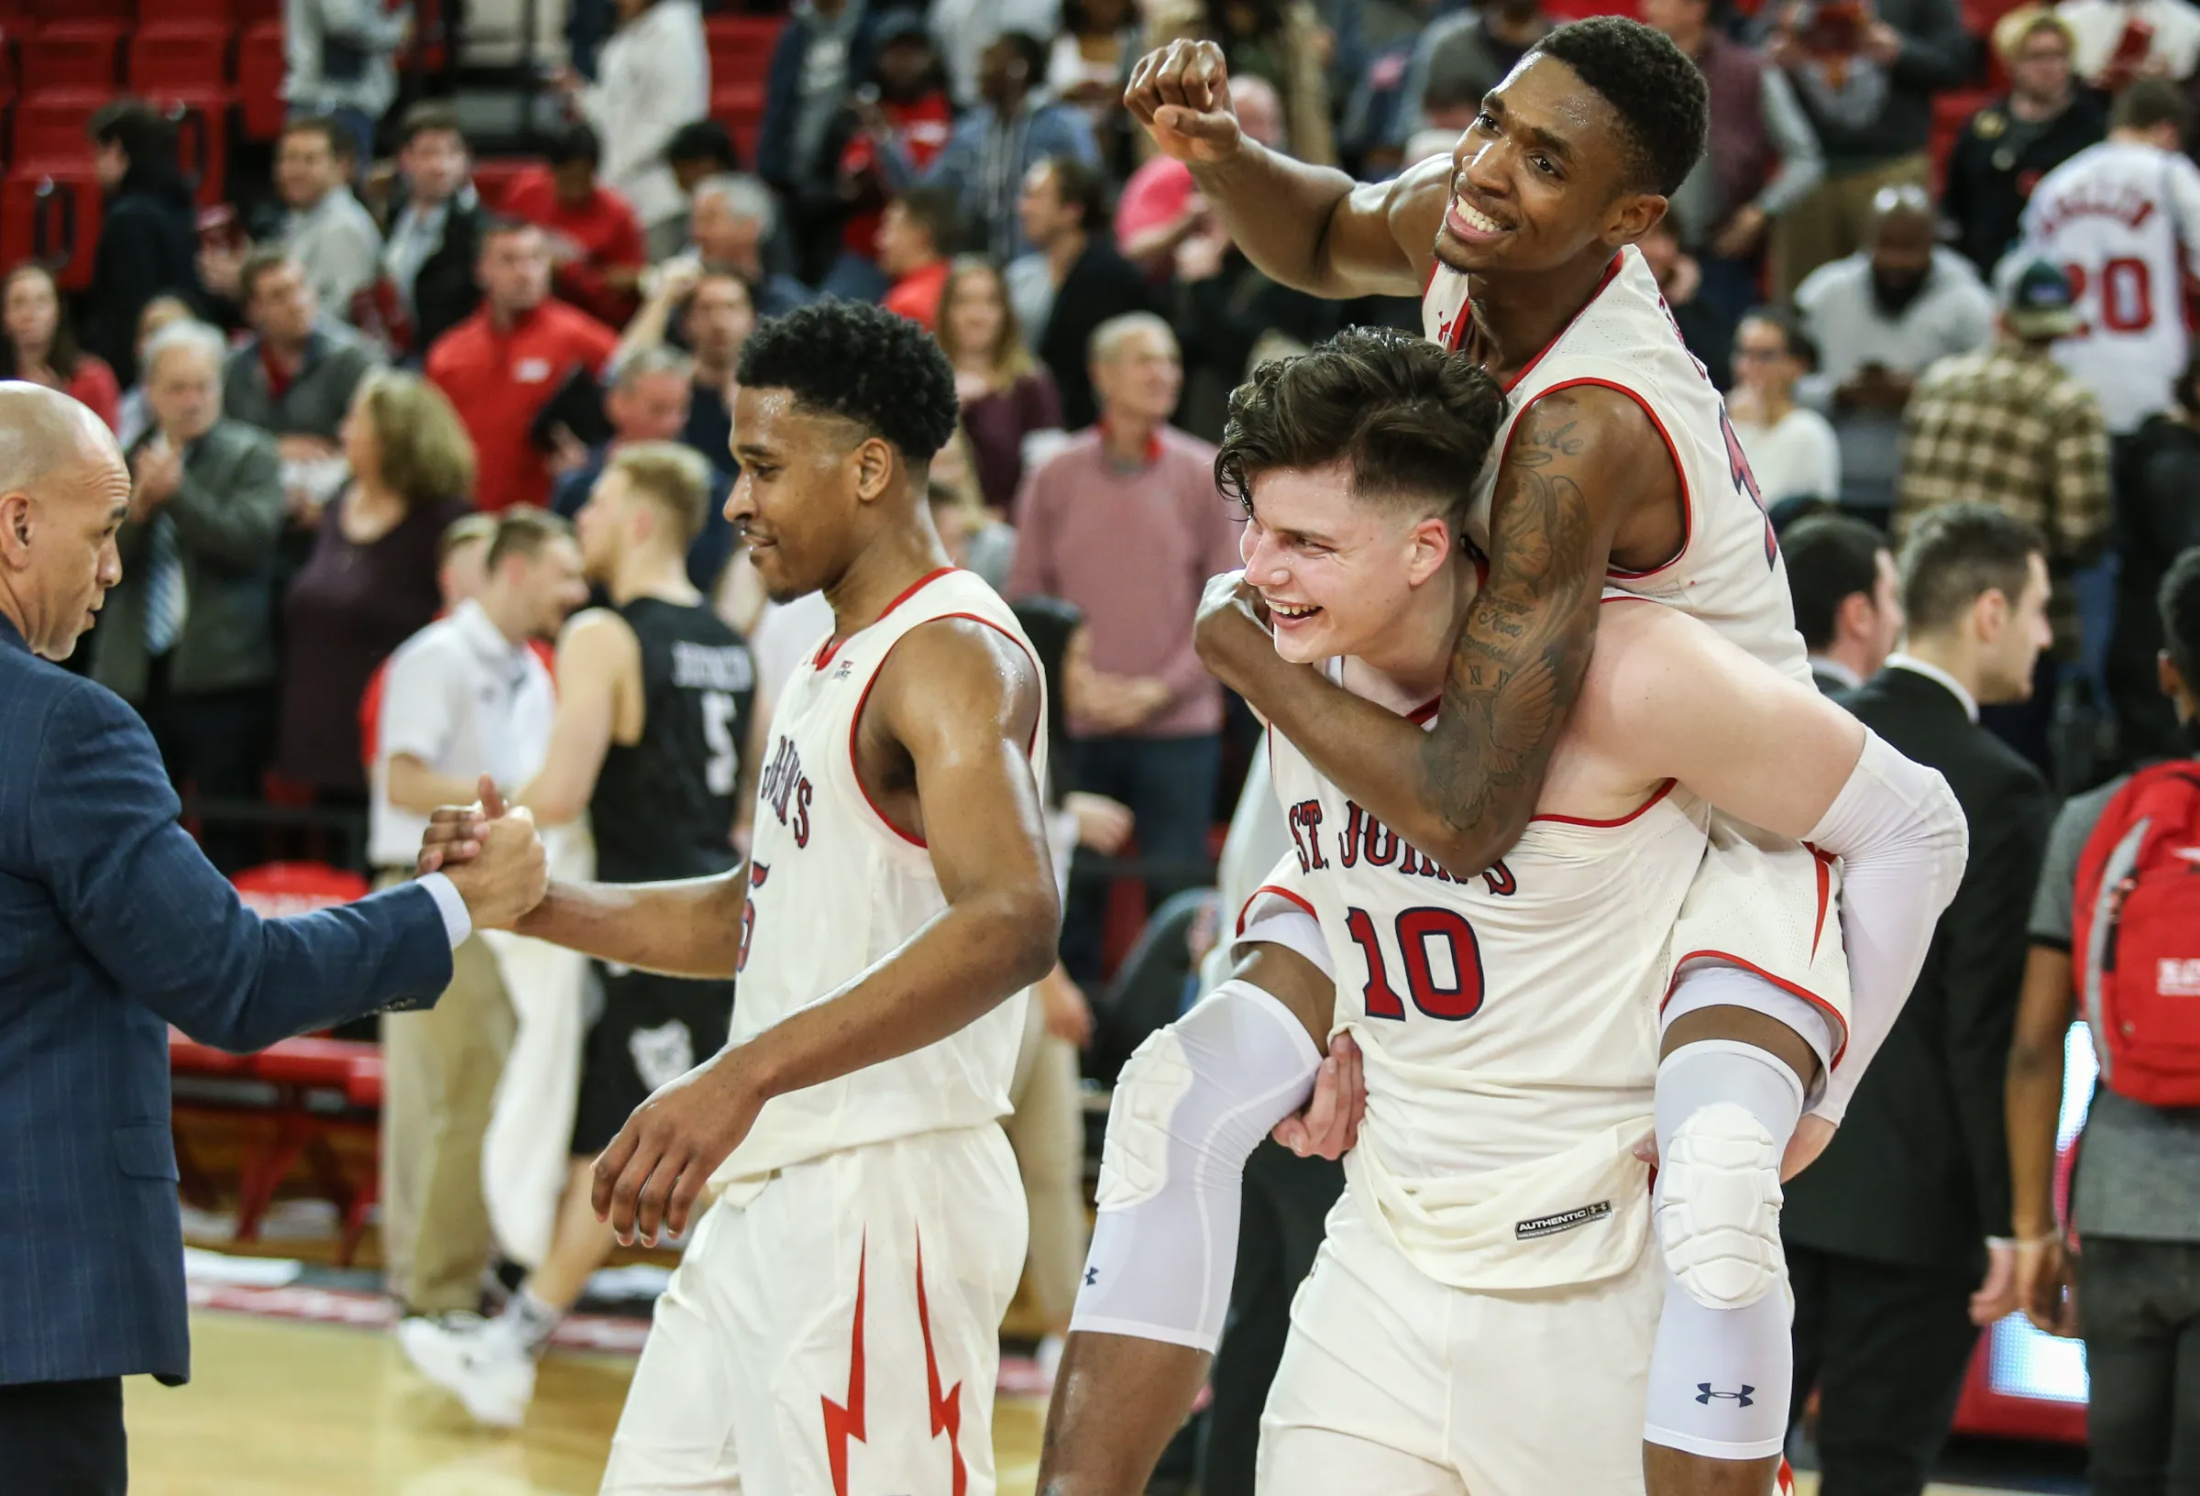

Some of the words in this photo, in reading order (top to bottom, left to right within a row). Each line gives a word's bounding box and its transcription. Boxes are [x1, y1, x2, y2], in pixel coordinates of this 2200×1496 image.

[701, 690, 738, 796] 5
[1289, 799, 1330, 876] ST.
[1344, 906, 1486, 1023] 10
[1518, 1209, 1587, 1232] AUTHENTIC
